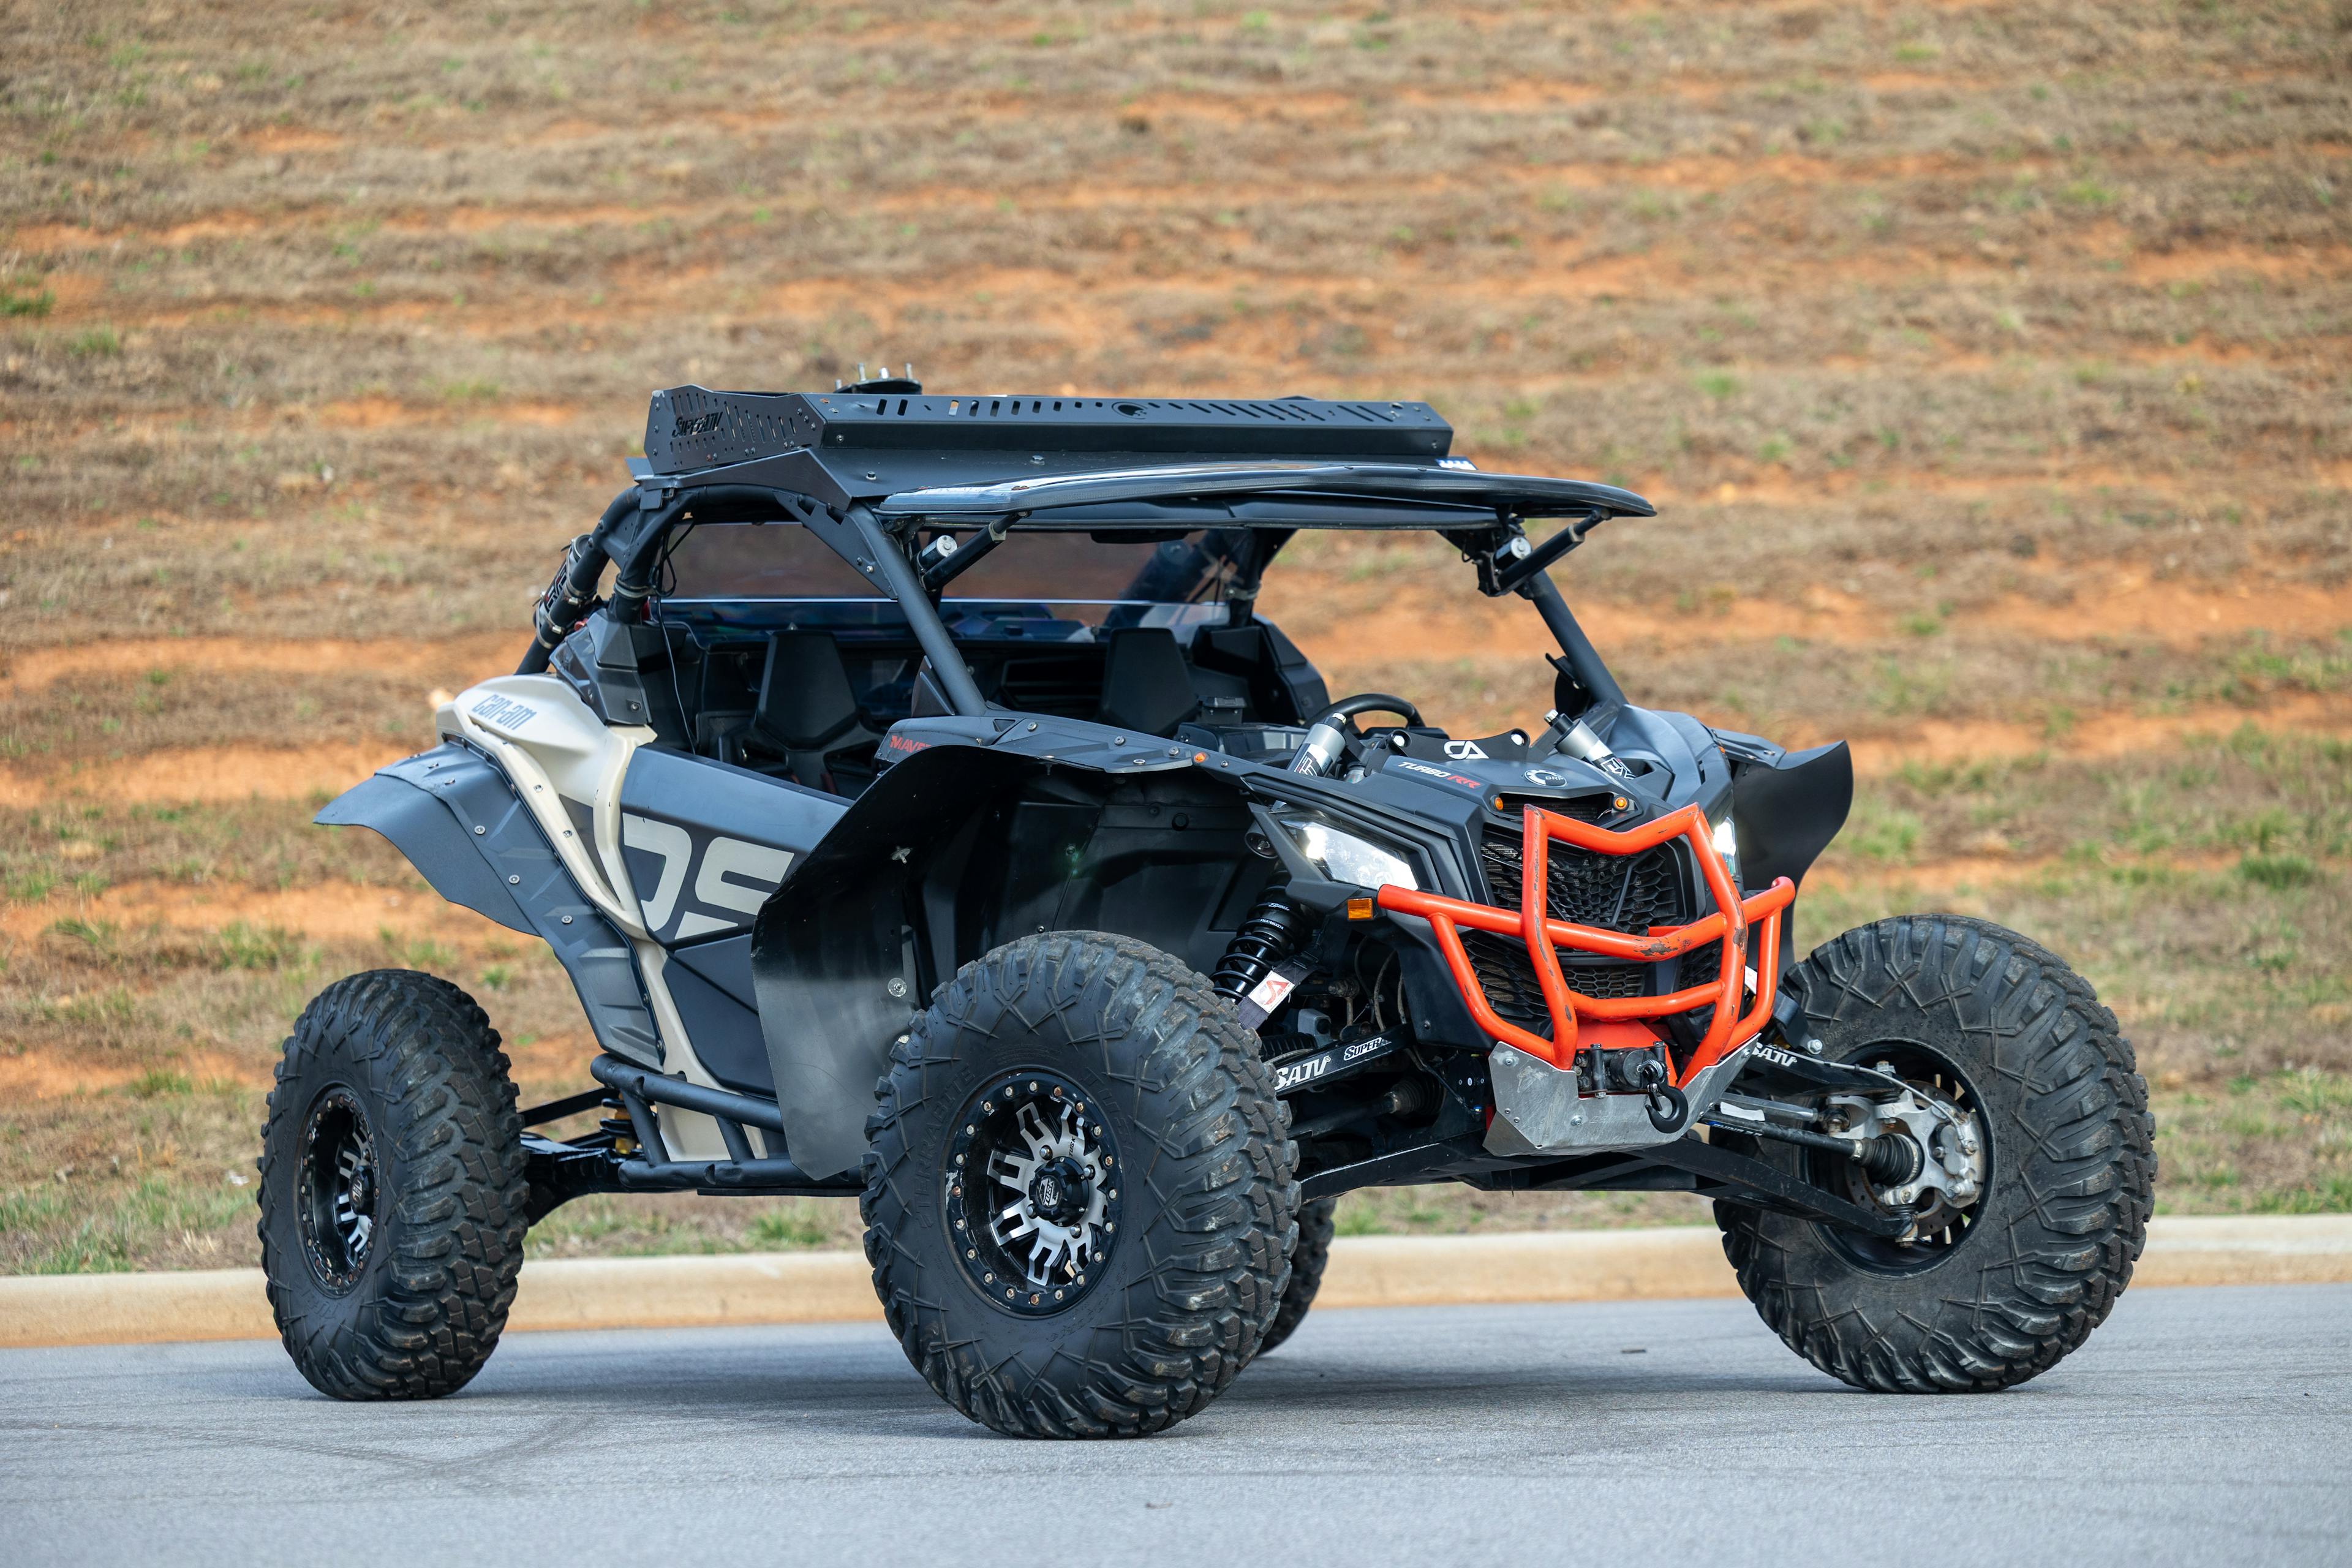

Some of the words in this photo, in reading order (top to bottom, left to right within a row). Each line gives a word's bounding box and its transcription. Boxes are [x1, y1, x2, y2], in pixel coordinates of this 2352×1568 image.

[889, 735, 932, 753] MAVE
[1398, 761, 1451, 778] TURBO
[1447, 775, 1481, 789] RR
[1068, 1136, 1077, 1157] TUSK
[1044, 1178, 1054, 1207] TUSK
